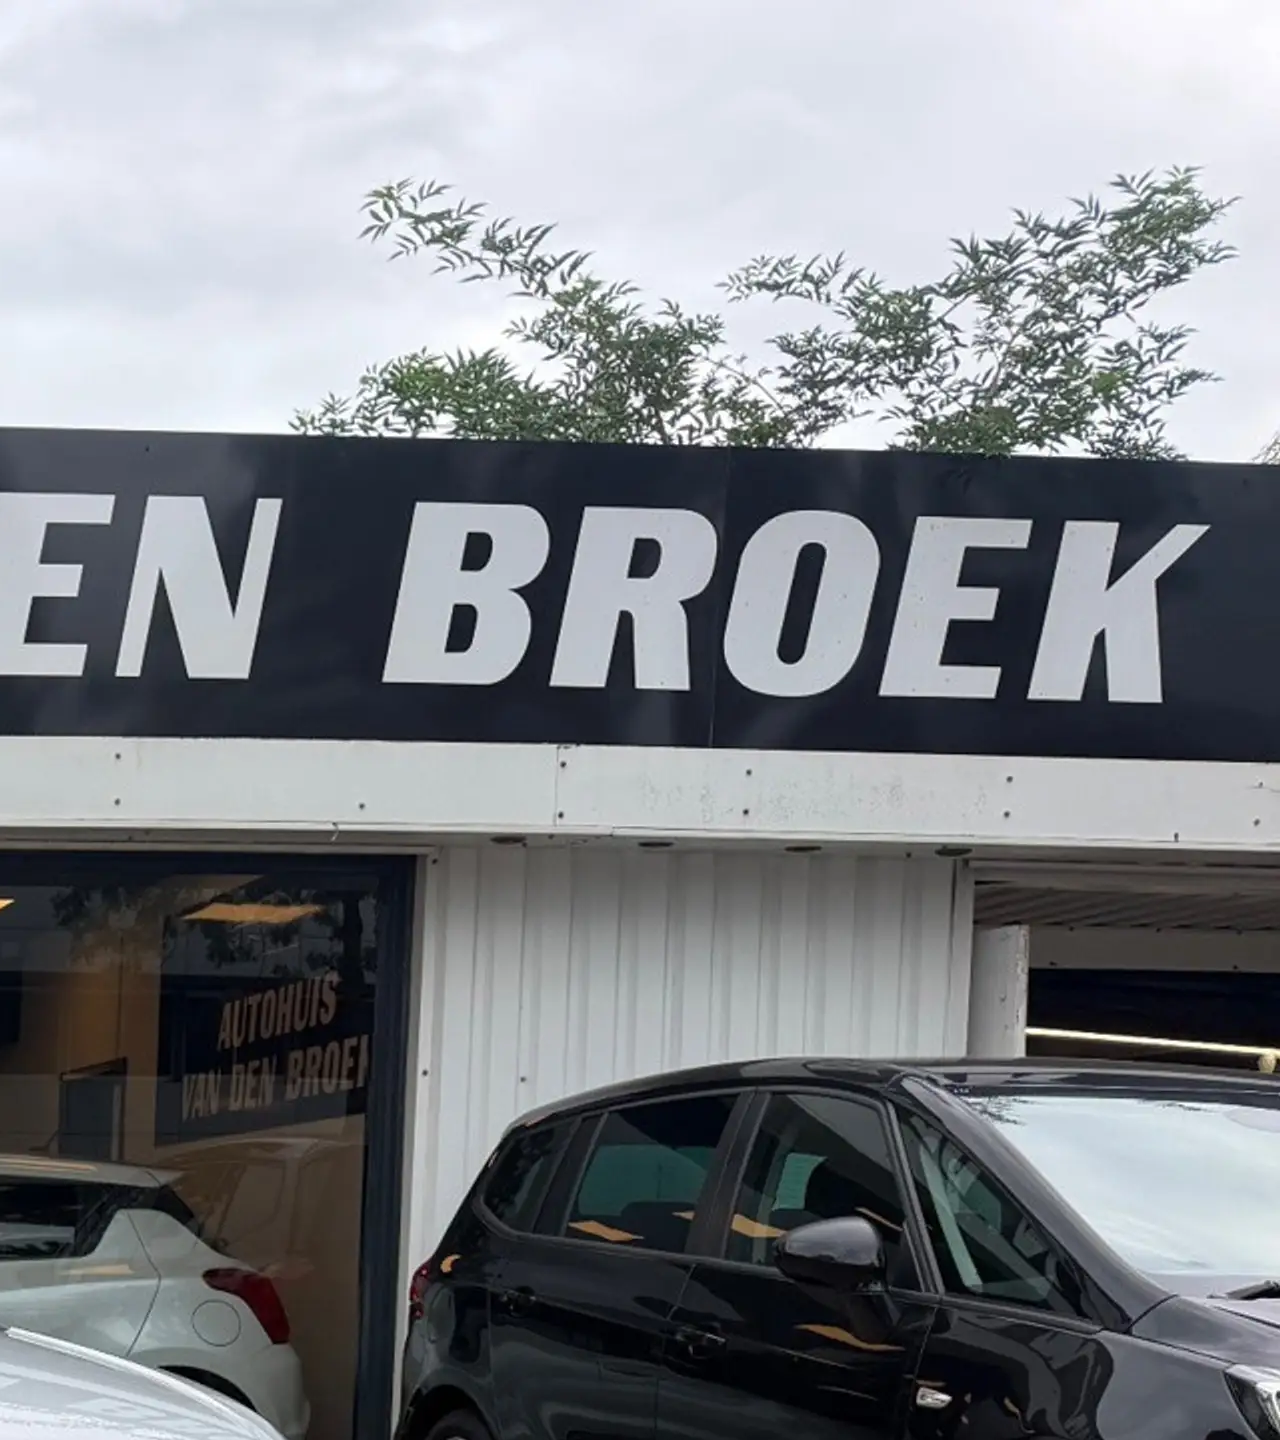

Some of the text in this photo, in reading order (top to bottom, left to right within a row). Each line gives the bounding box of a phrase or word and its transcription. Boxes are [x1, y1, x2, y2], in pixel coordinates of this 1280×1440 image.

[381, 500, 1212, 704] BROEK
[216, 972, 342, 1051] AUTOHUIS
[182, 1067, 222, 1122] VAN
[229, 1054, 277, 1111] DEN
